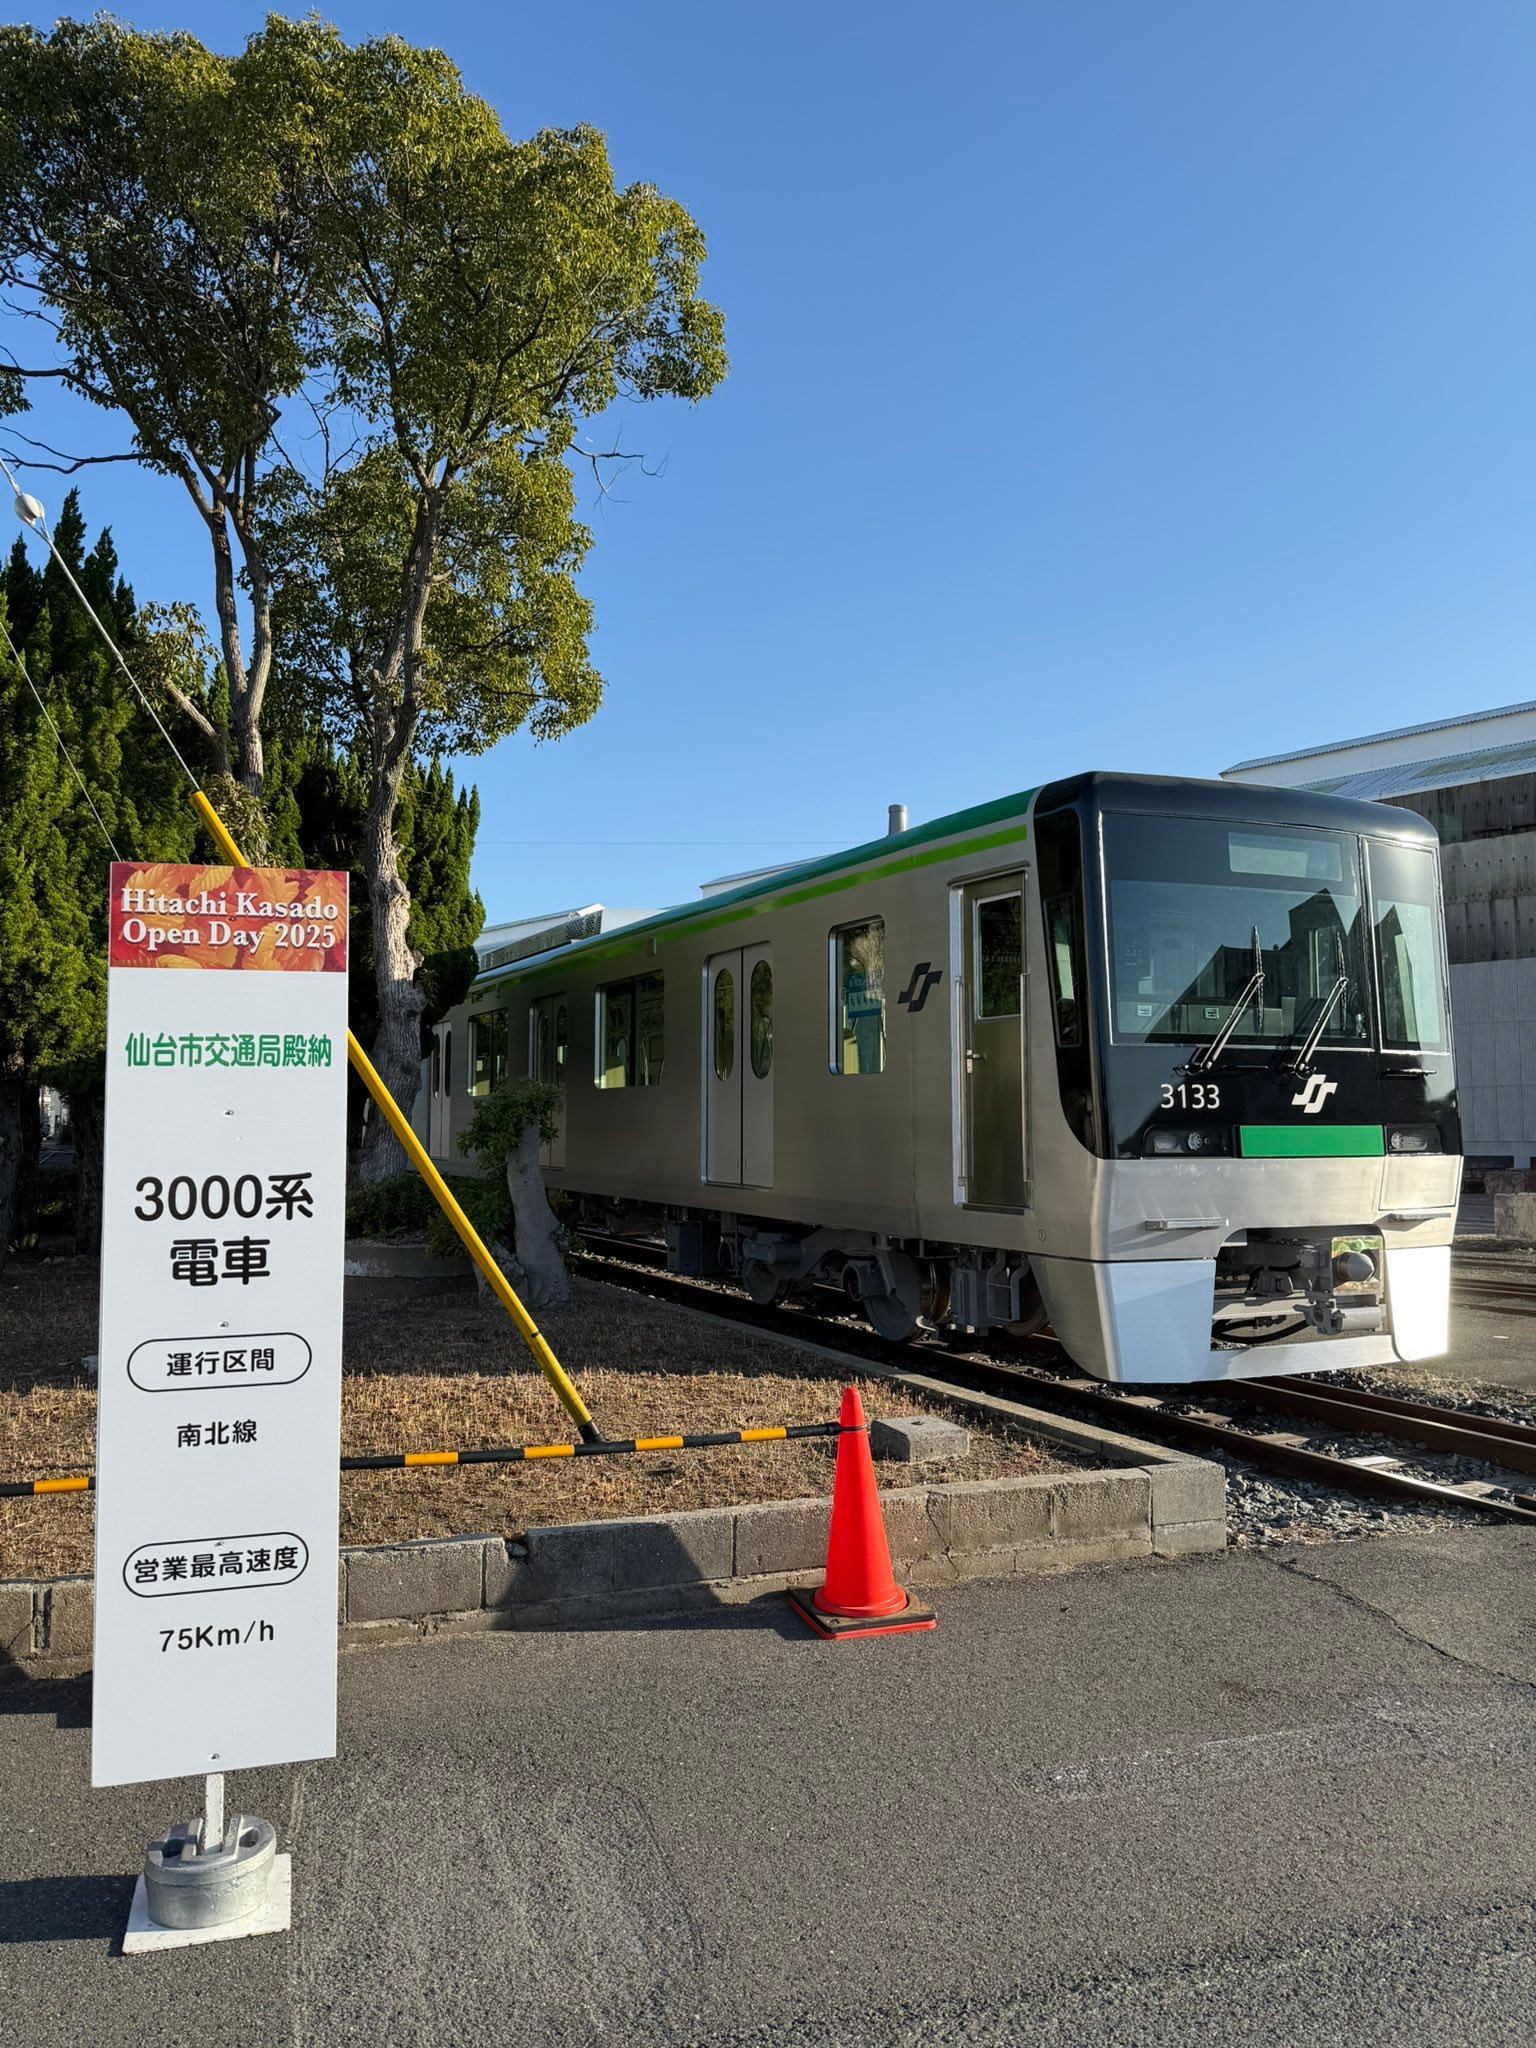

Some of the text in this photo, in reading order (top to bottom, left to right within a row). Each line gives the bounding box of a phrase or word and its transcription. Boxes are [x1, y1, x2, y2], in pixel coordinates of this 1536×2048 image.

[121, 887, 339, 920] Hitachi Kasado
[122, 918, 337, 954] Open Day 2025
[125, 1032, 333, 1068] 仙台市交通局殿納
[1160, 1083, 1221, 1110] 3133
[134, 1171, 314, 1222] 3000系
[169, 1235, 271, 1287] 電車
[166, 1347, 276, 1377] 運行区間
[176, 1418, 258, 1449] 南北線
[134, 1545, 299, 1584] 営業最高速度
[159, 1619, 275, 1653] 75Km/h
